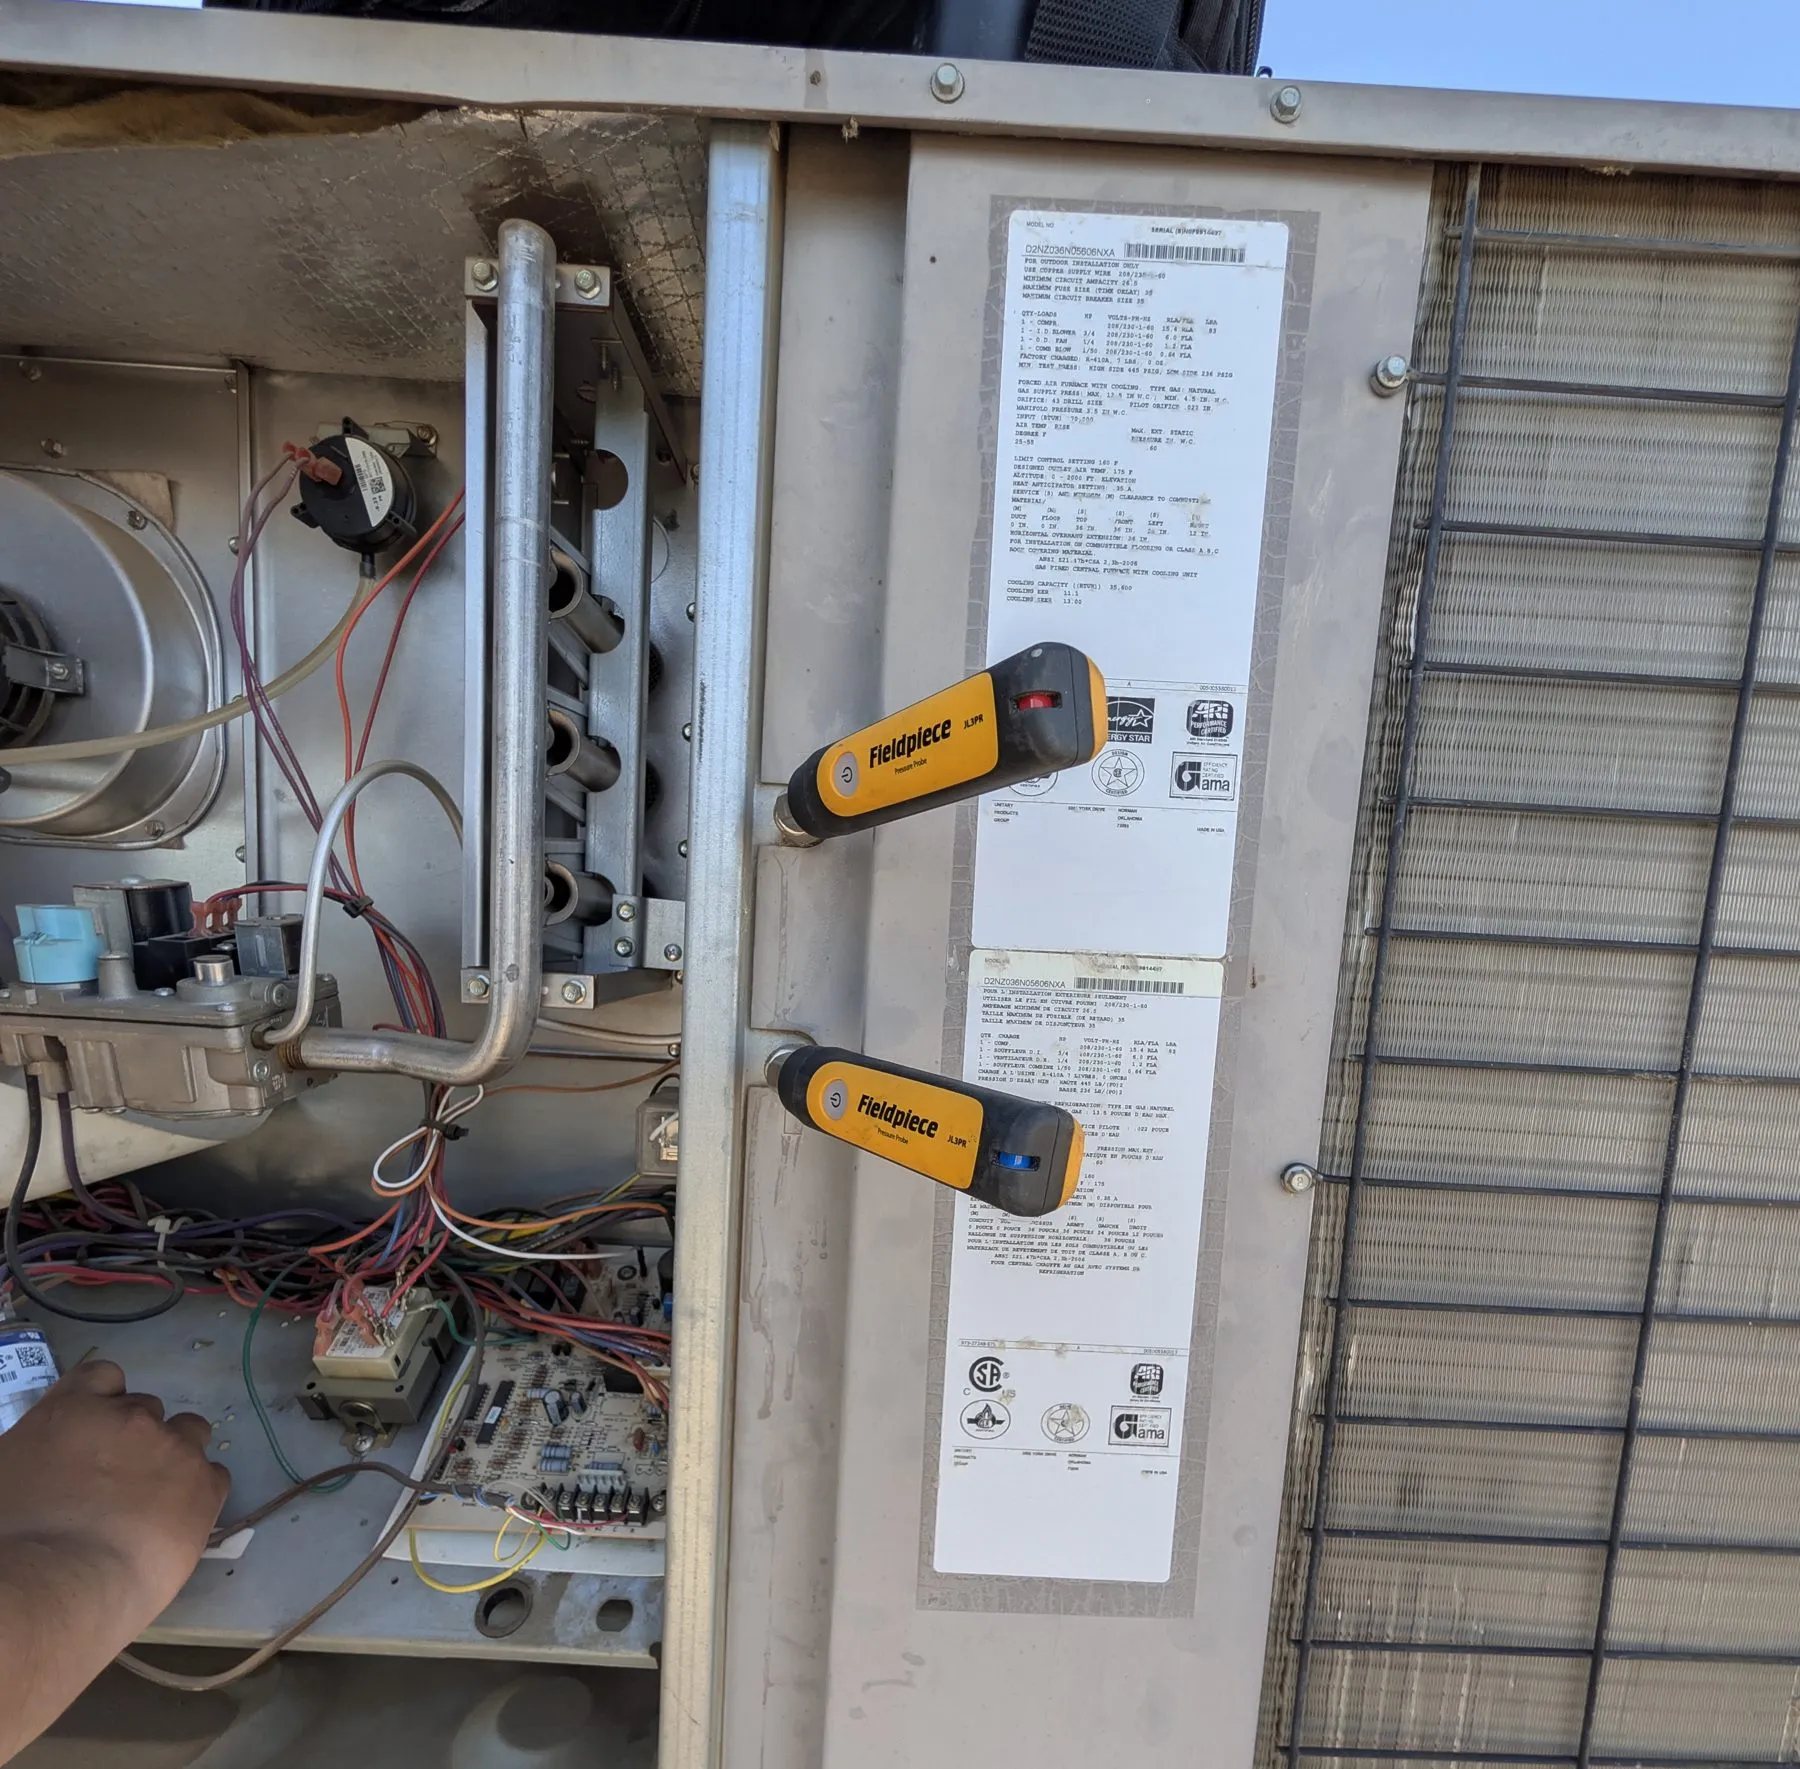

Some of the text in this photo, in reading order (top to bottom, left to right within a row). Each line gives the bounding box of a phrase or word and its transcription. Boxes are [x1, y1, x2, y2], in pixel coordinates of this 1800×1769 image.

[1040, 257, 1069, 266] OUTDOOR
[1071, 259, 1120, 268] INSTALLATION
[1067, 267, 1092, 276] SUPPLY
[1023, 274, 1119, 286] MINIMUM CIRCUIT AMPACITY
[1022, 283, 1051, 291] MAXIMUM
[1053, 293, 1082, 302] CIRCUIT
[1019, 352, 1047, 360] FACTORY
[1037, 455, 1065, 464] CONTROL
[869, 714, 984, 768] Fieldpiece JL3PR
[1128, 734, 1150, 742] STAR
[894, 757, 928, 775] Pressure Probe
[858, 1094, 967, 1148] Fieldpiece JL3PR
[877, 1127, 895, 1140] Pressure
[968, 1356, 1004, 1392] CSA
[962, 1387, 972, 1396] C
